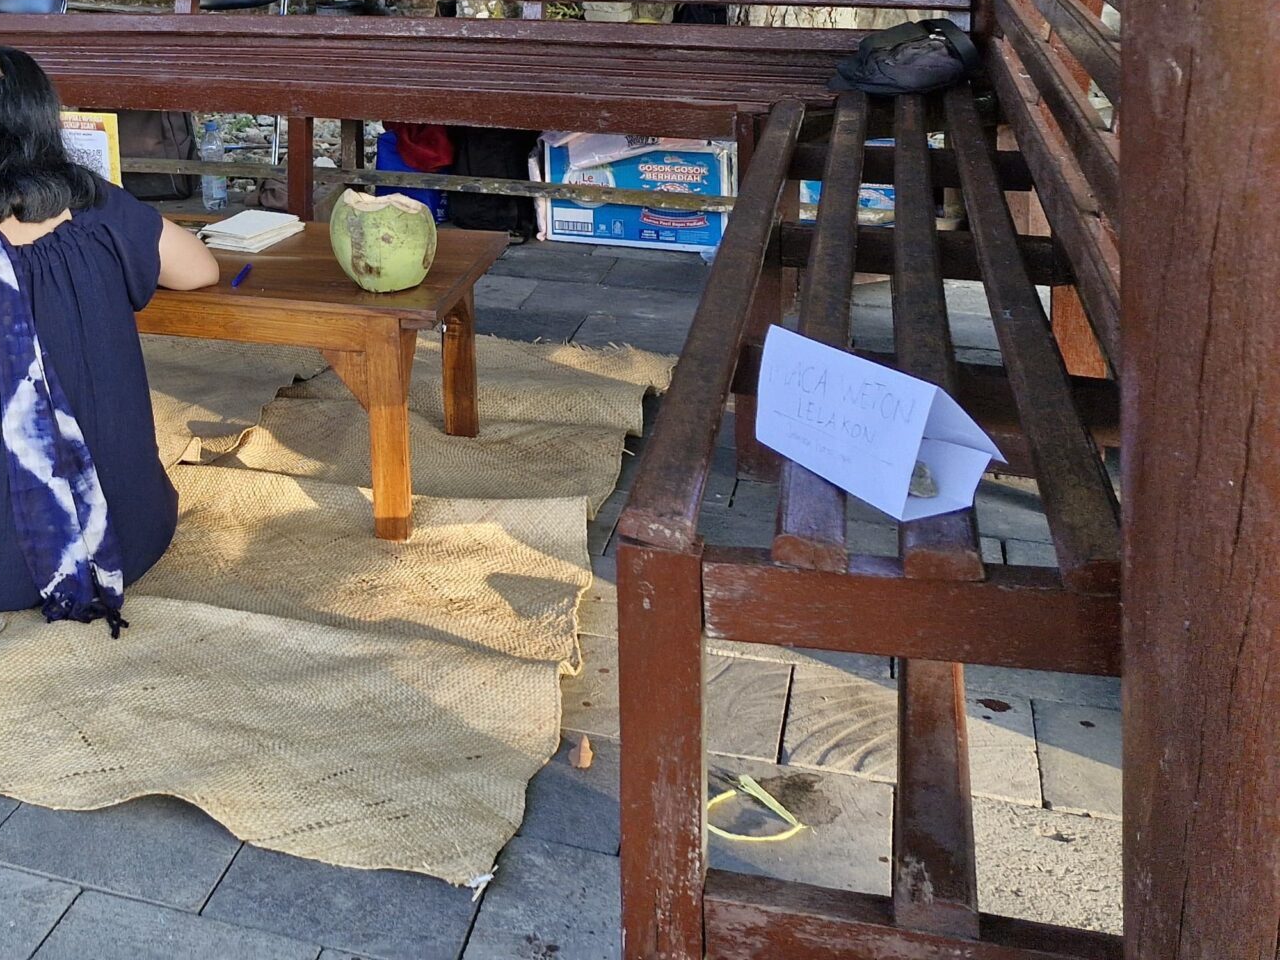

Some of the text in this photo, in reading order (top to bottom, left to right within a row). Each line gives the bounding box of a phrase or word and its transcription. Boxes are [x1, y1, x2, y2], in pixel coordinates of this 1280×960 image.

[639, 164, 709, 175] GOSOK-GOSOK
[582, 172, 593, 182] Le
[645, 173, 701, 182] BERHADIAH
